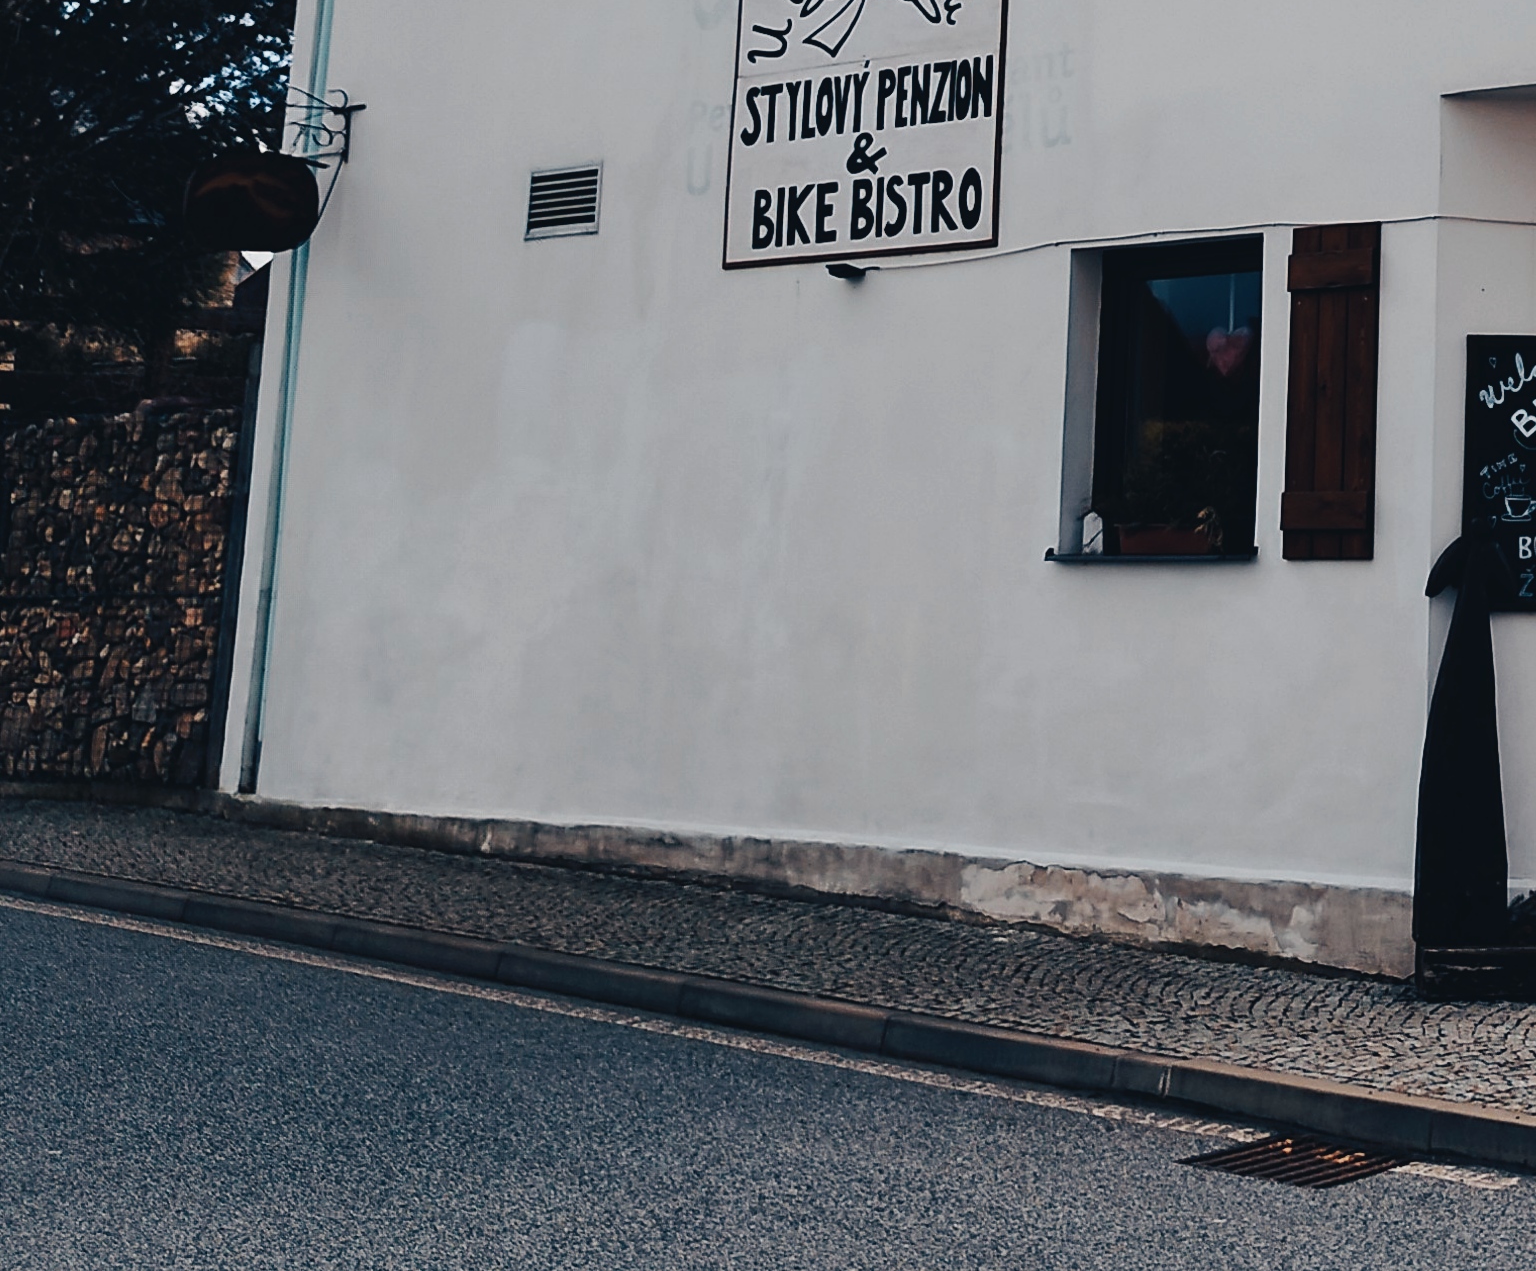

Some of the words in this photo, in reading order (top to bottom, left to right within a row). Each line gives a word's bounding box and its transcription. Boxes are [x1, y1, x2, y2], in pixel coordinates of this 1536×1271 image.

[747, 18, 793, 64] U
[740, 60, 870, 147] STYLOVÝ
[875, 54, 994, 132] PENZION
[846, 132, 888, 175] &
[751, 181, 839, 250] BIKE
[849, 166, 983, 241] BISTRO
